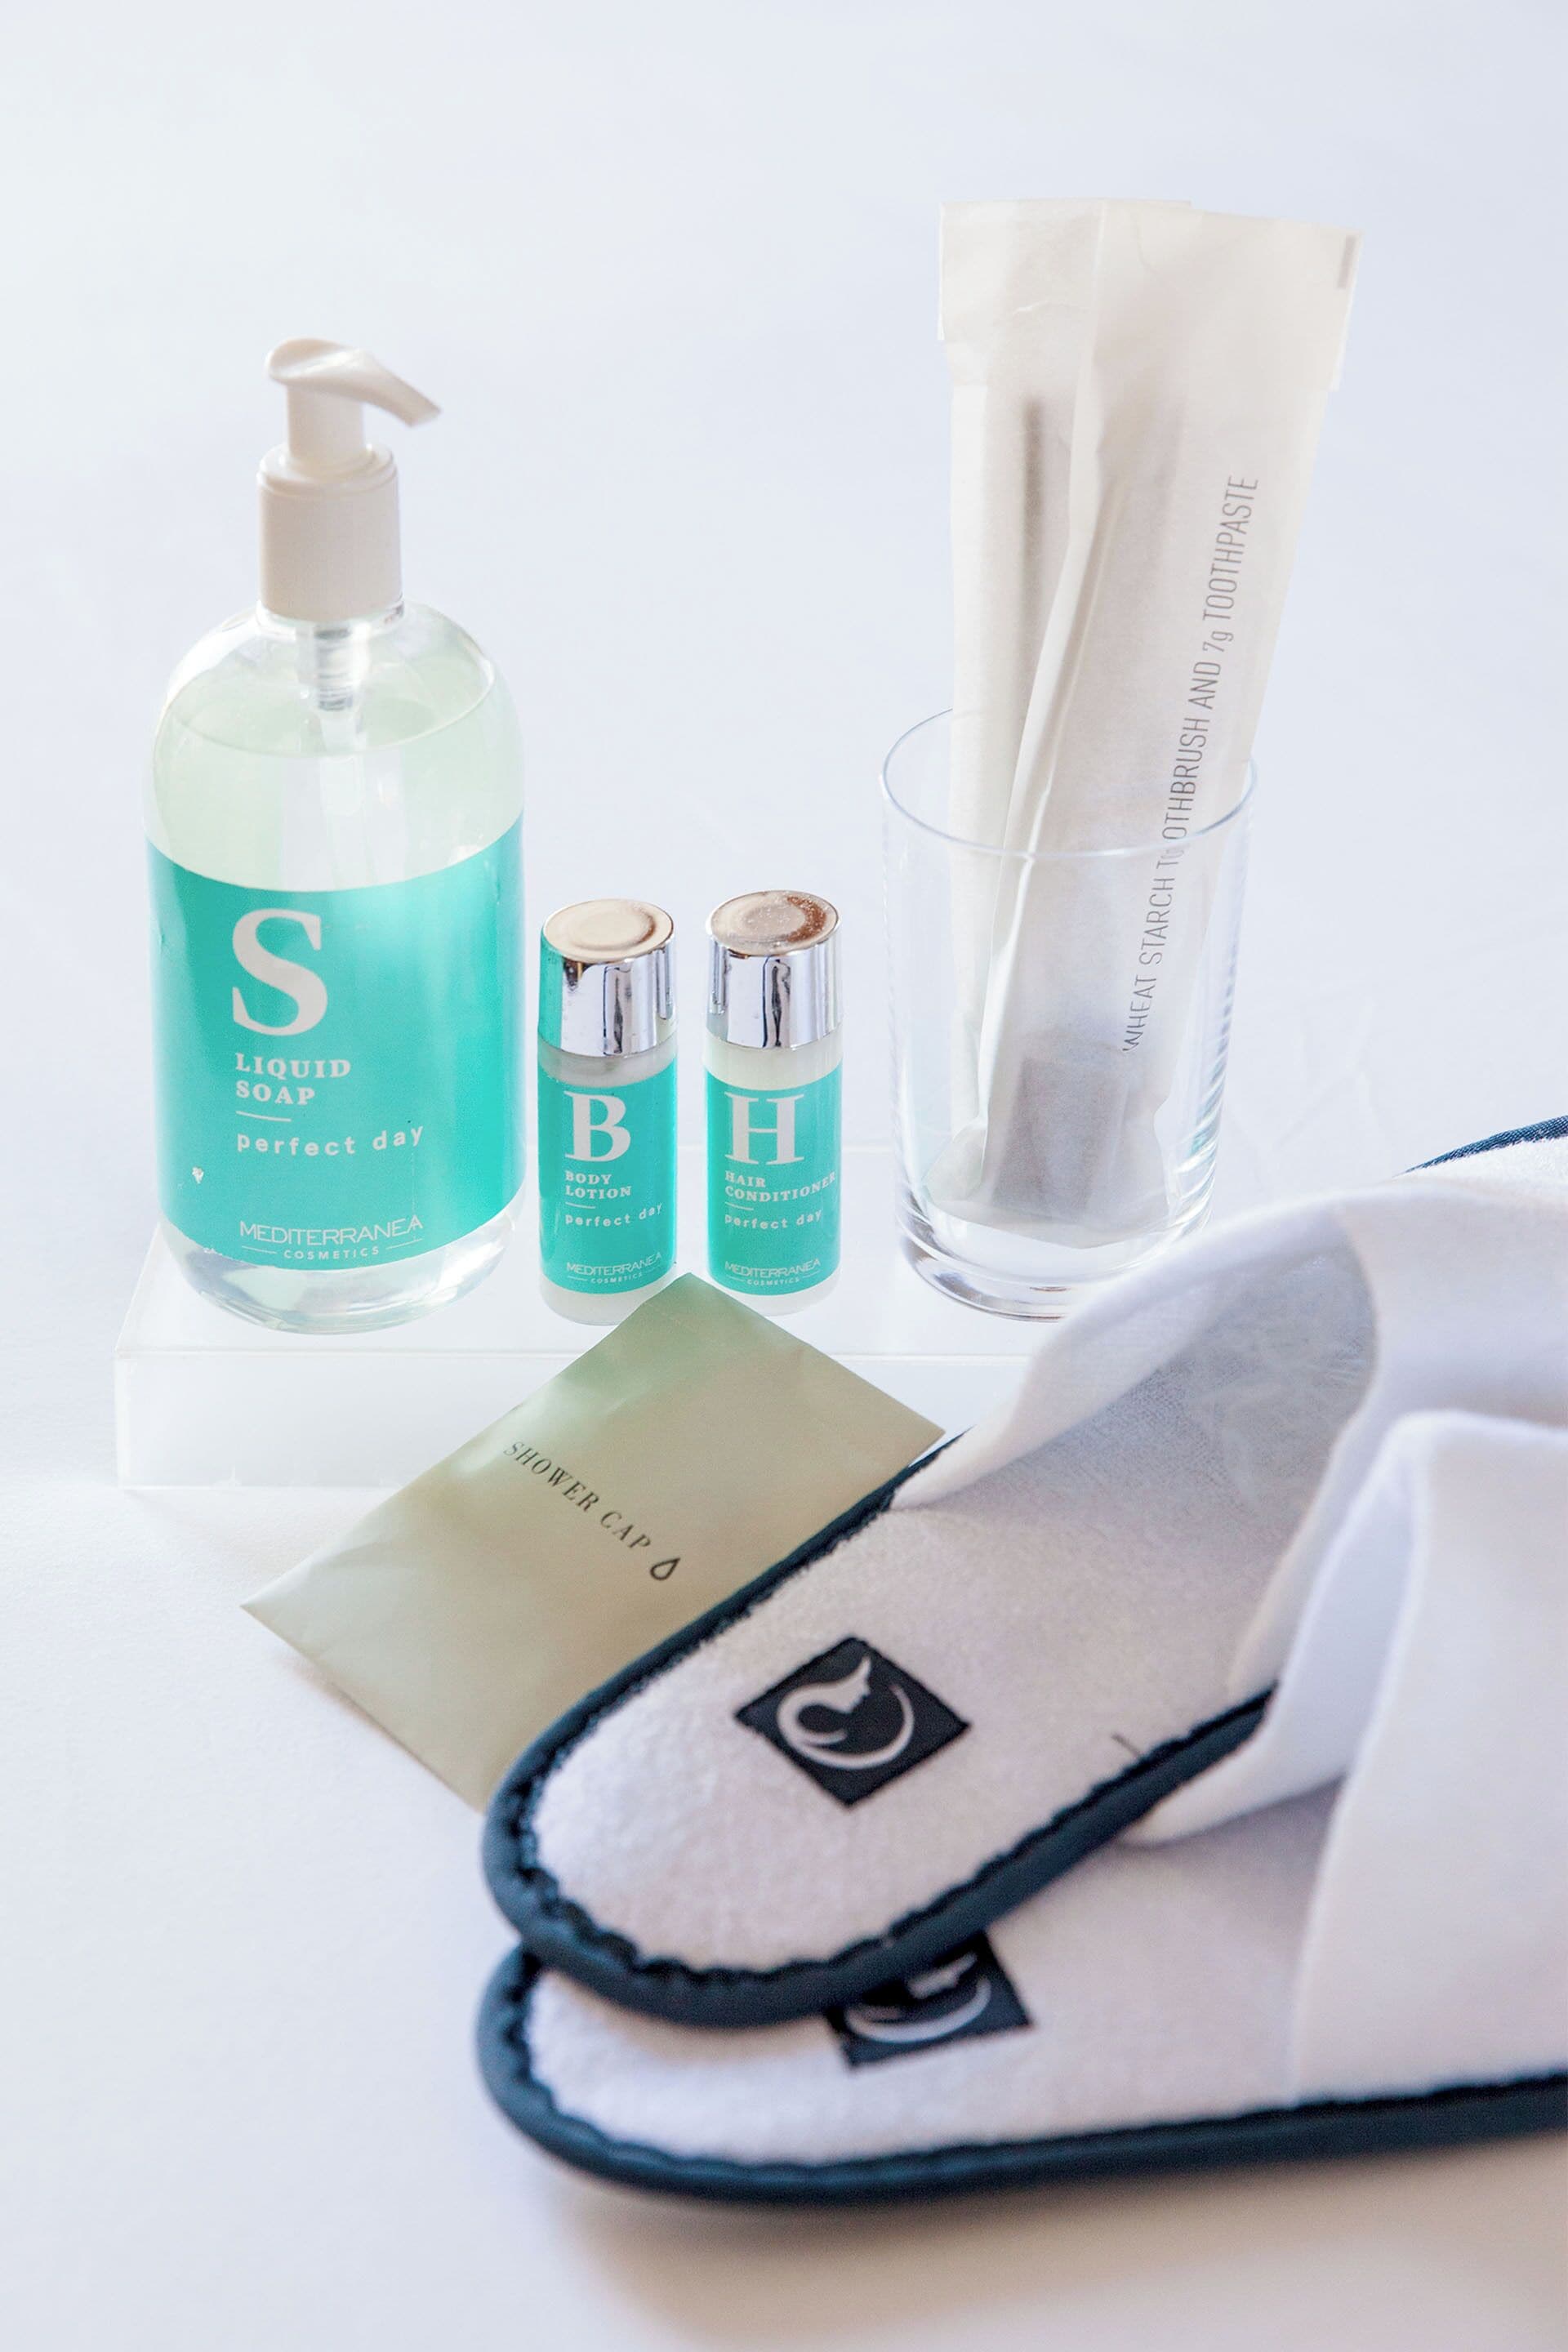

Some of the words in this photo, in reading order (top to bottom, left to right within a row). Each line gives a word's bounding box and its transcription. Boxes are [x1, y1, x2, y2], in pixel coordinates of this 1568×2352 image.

[1203, 474, 1258, 622] TOOTHPASTE
[1202, 630, 1235, 653] 7g
[1187, 659, 1222, 710] AND
[1138, 877, 1176, 965] STARCH
[232, 908, 328, 1036] S
[1122, 974, 1157, 1052] WHEAT
[234, 1053, 351, 1078] LIQUID
[235, 1080, 315, 1105] SOAP
[564, 1090, 631, 1162] B
[724, 1092, 804, 1165] H
[237, 1132, 355, 1156] perfect
[372, 1125, 424, 1150] day
[564, 1170, 612, 1185] BODY
[724, 1171, 836, 1203] CONDITIONER
[725, 1170, 766, 1187] HAIR
[565, 1185, 631, 1199] LOTION
[565, 1213, 630, 1227] perfect
[639, 1203, 662, 1220] day
[724, 1214, 788, 1229] perfect
[796, 1210, 822, 1227] day
[238, 1214, 424, 1246] MEDITERRANEA
[283, 1245, 380, 1260] COSMETICS
[566, 1251, 662, 1276] MEDITERRANEA
[590, 1272, 643, 1284] COSMETICS
[724, 1258, 822, 1278] MEDITERRANEA
[746, 1276, 800, 1285] COSMETICS
[503, 1441, 599, 1512] SHOWER
[600, 1511, 651, 1548] CAP
